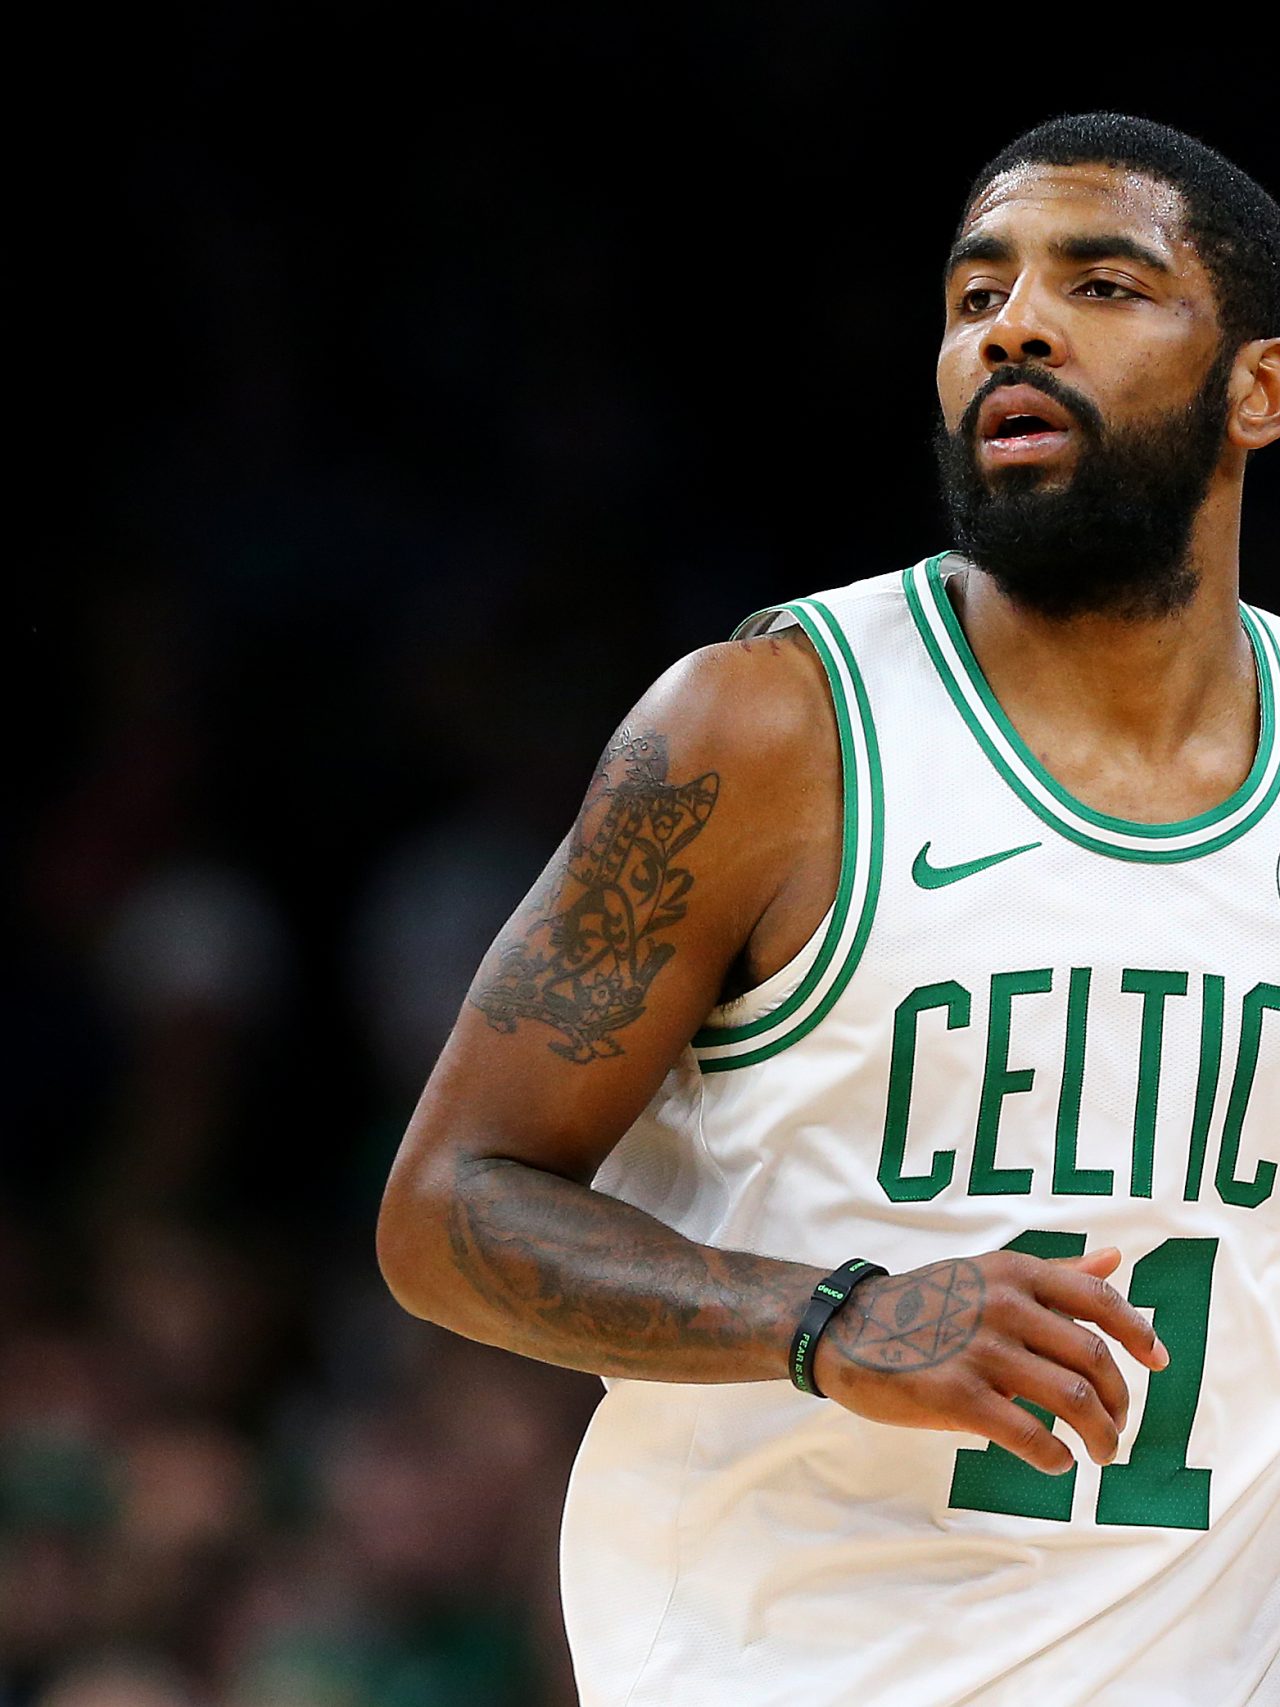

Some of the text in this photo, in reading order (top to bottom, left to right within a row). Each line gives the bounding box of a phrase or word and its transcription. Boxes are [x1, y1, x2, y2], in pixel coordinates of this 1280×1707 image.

[817, 1284, 844, 1299] deuce
[795, 1333, 810, 1362] FEAR
[795, 1362, 803, 1374] IS
